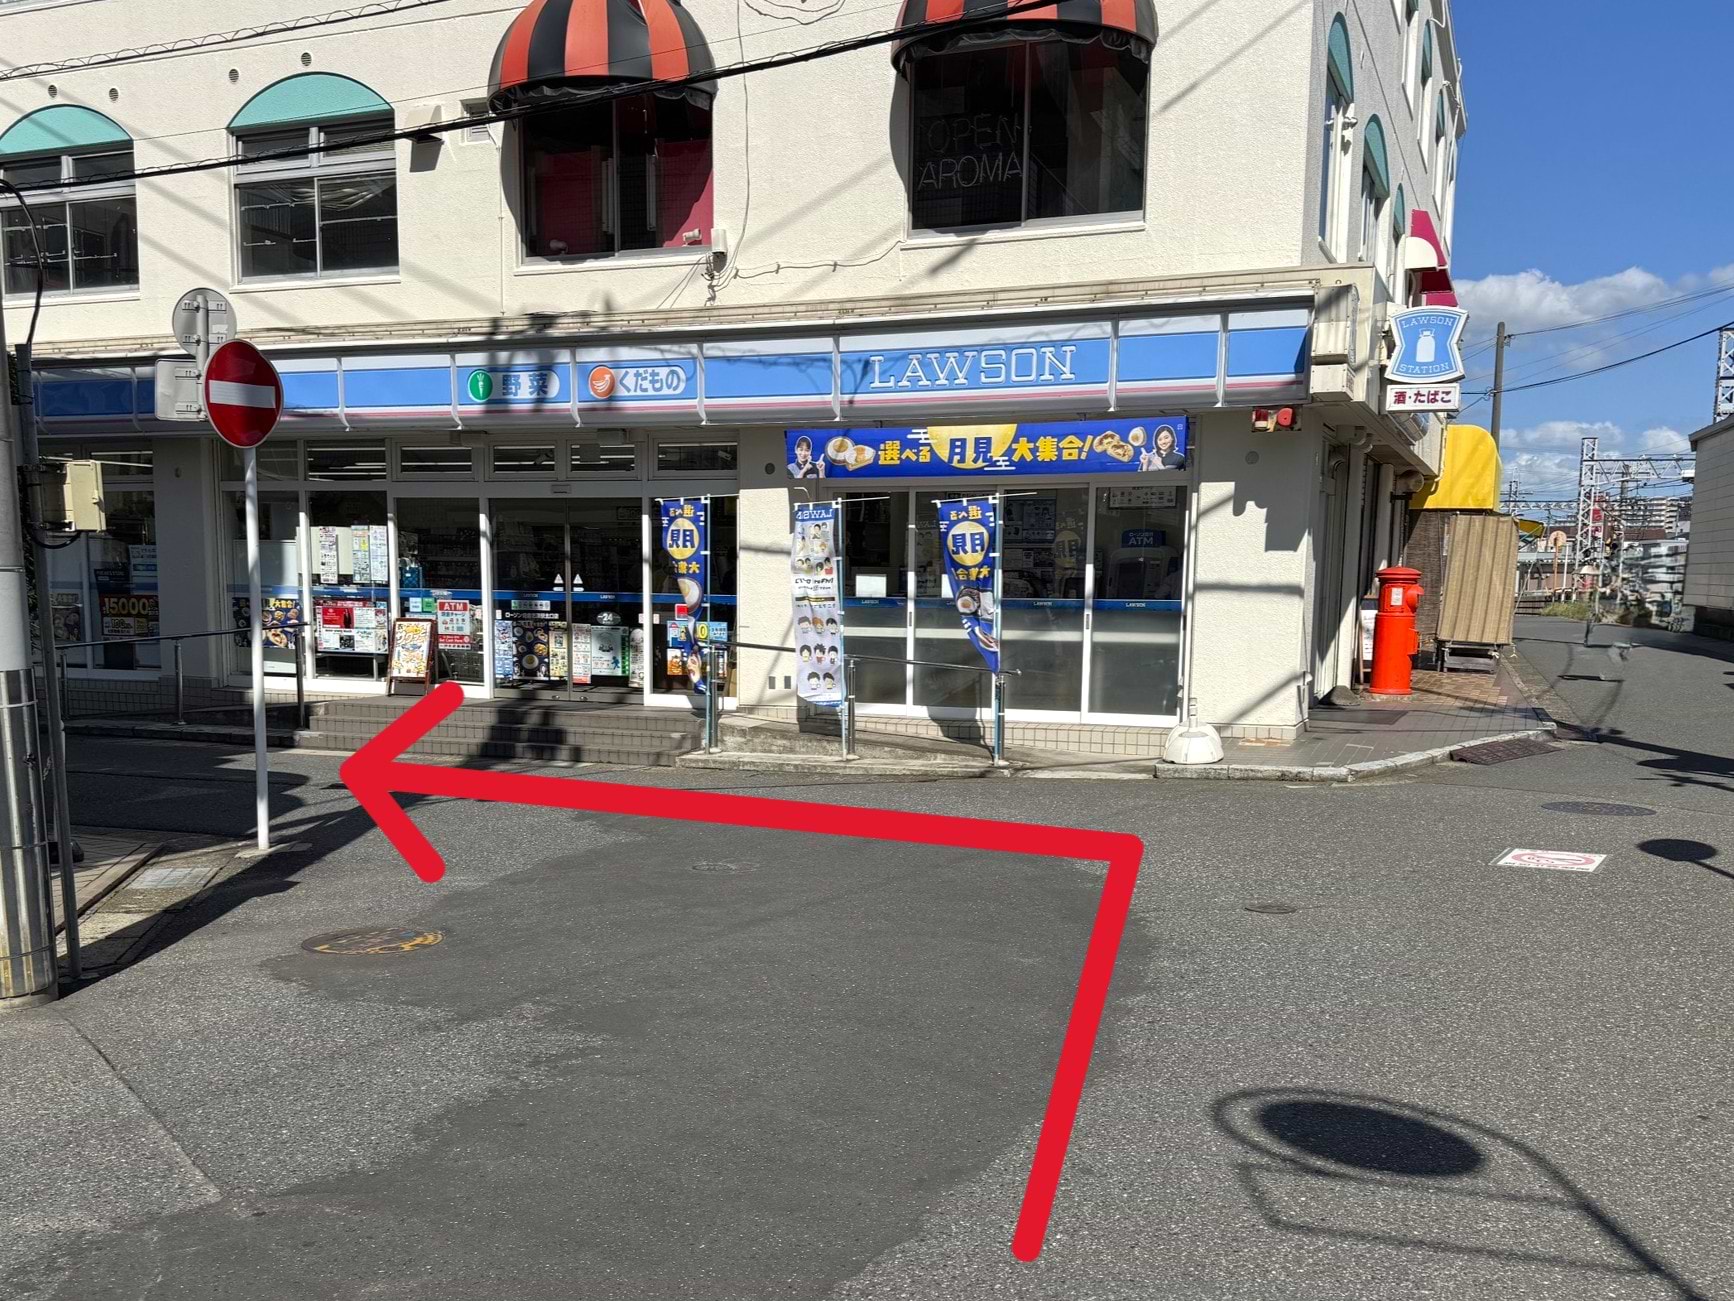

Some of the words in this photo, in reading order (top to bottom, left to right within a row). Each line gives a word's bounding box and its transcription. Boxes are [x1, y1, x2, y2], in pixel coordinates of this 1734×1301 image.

[927, 113, 1020, 151] OPEN
[917, 152, 1022, 191] AROMA
[1402, 315, 1452, 328] LAWSON
[868, 345, 1077, 389] LAWSON
[1399, 363, 1449, 374] STATION
[502, 371, 549, 397] 野菜
[619, 369, 680, 392] くだもの
[1394, 390, 1452, 404] 酒・たばこ
[878, 440, 931, 465] 選べる
[949, 437, 994, 465] 月見
[1012, 434, 1093, 462] 大集合!
[1128, 537, 1154, 545] ATM
[443, 603, 464, 611] ATM
